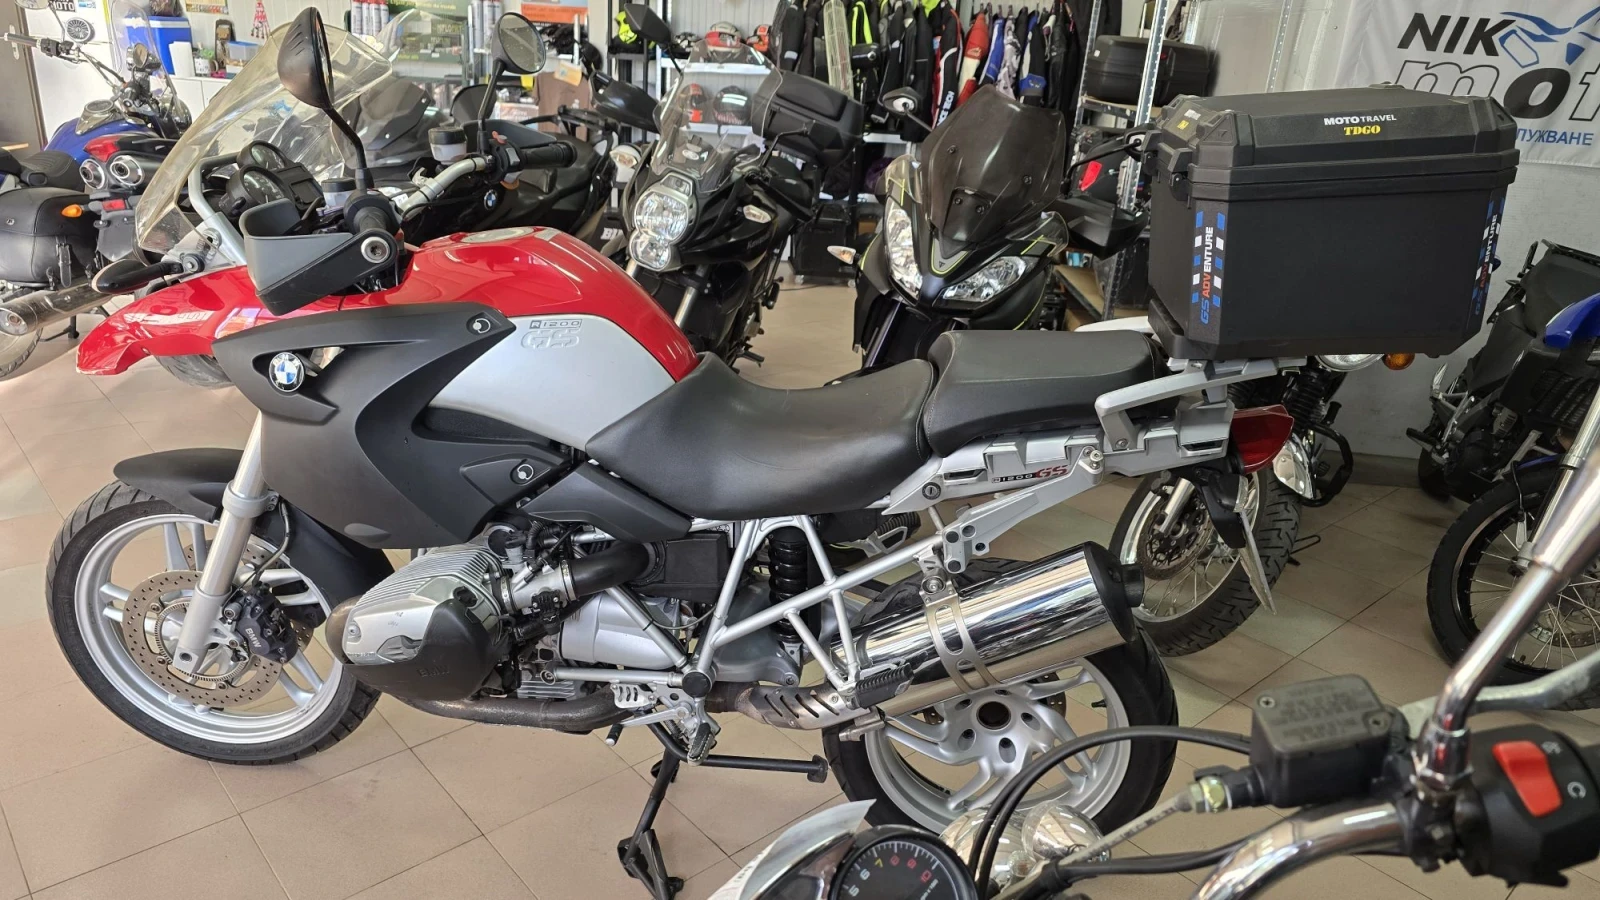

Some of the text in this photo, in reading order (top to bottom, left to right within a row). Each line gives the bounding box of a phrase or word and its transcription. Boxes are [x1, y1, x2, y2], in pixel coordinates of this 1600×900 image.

[1397, 12, 1516, 57] NIK
[1343, 124, 1381, 136] TDGO
[1200, 226, 1213, 324] GS ADVENTURE
[529, 319, 582, 329] R1200
[520, 329, 580, 349] GS
[1035, 464, 1069, 479] GS
[245, 627, 262, 648] BMW
[875, 858, 883, 868] 7
[860, 868, 870, 880] 6
[849, 885, 860, 897] 5
